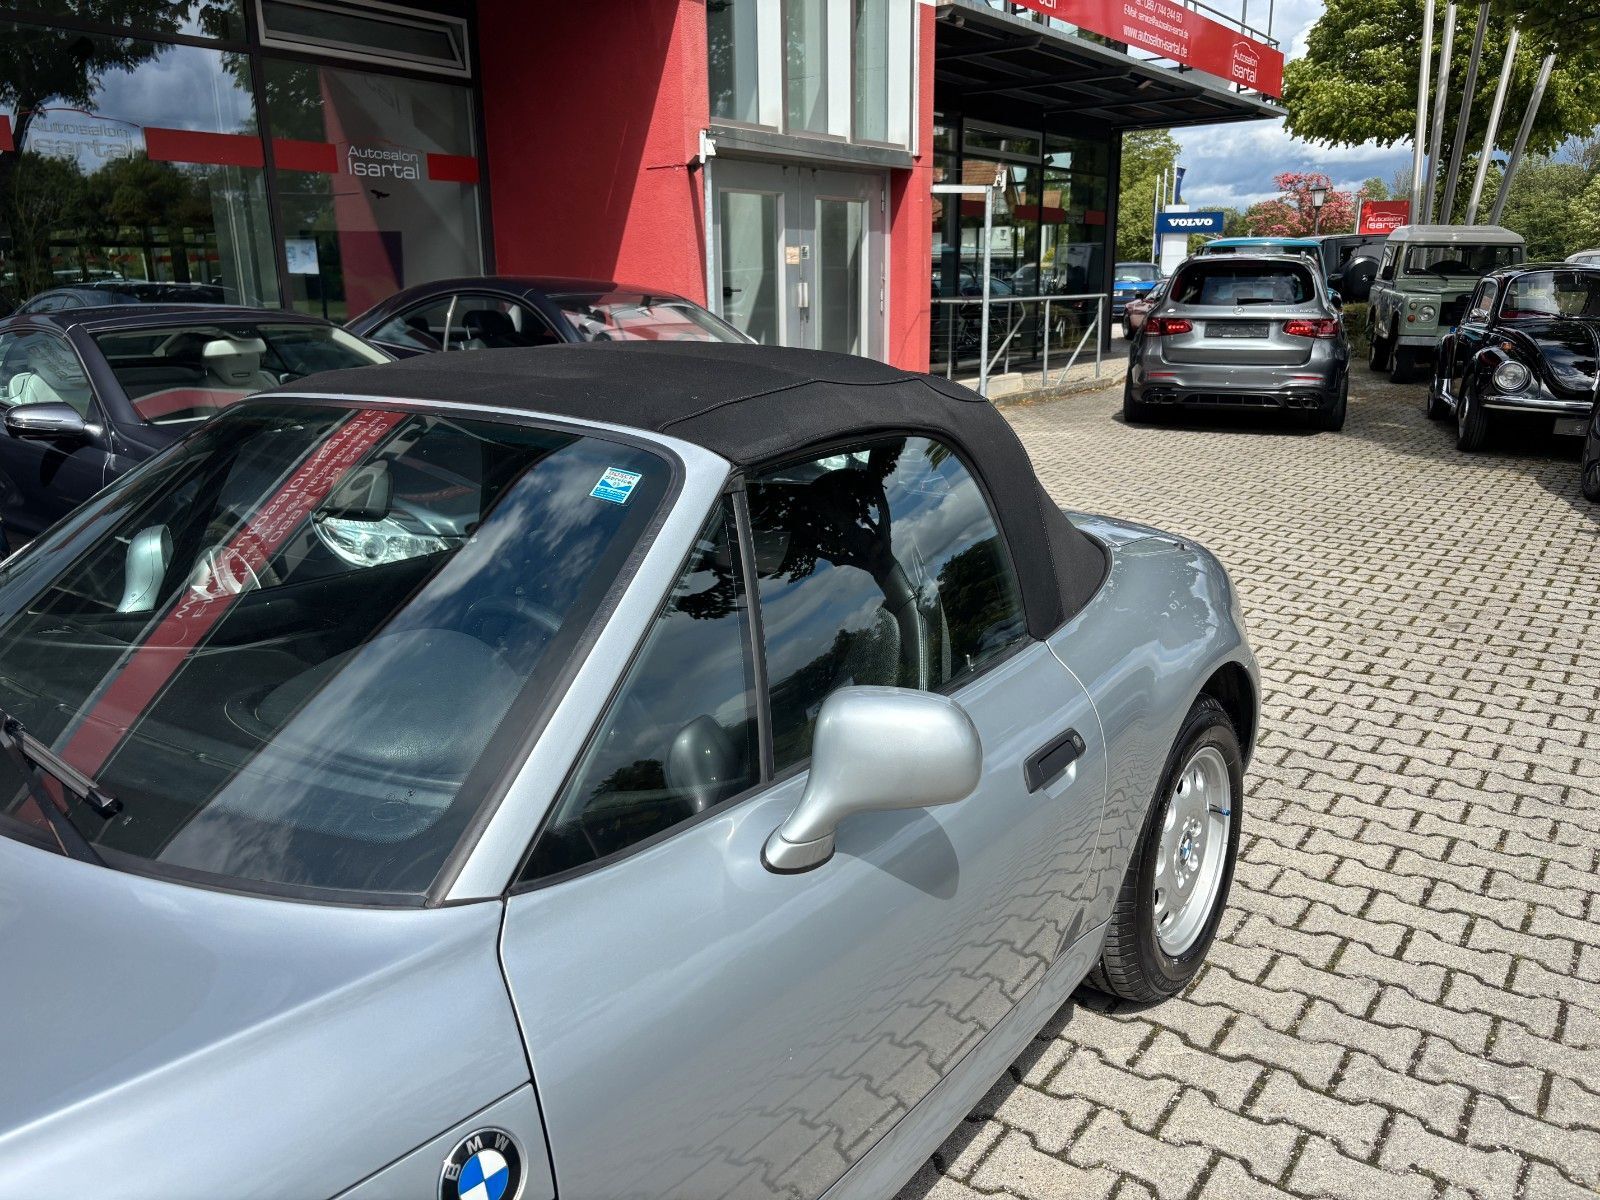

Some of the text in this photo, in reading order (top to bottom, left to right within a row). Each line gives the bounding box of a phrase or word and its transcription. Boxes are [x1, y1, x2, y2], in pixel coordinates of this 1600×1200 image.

[1123, 24, 1188, 58] www.autosalon-isartal.de
[1233, 48, 1258, 68] Autosalon
[1231, 58, 1257, 84] Isartal
[30, 120, 131, 139] Autosalon
[347, 145, 419, 162] Autosalon
[347, 157, 421, 180] Isartal
[1167, 217, 1214, 227] VOLVO
[1367, 215, 1404, 223] Autosalon
[445, 1133, 510, 1181] BMW
